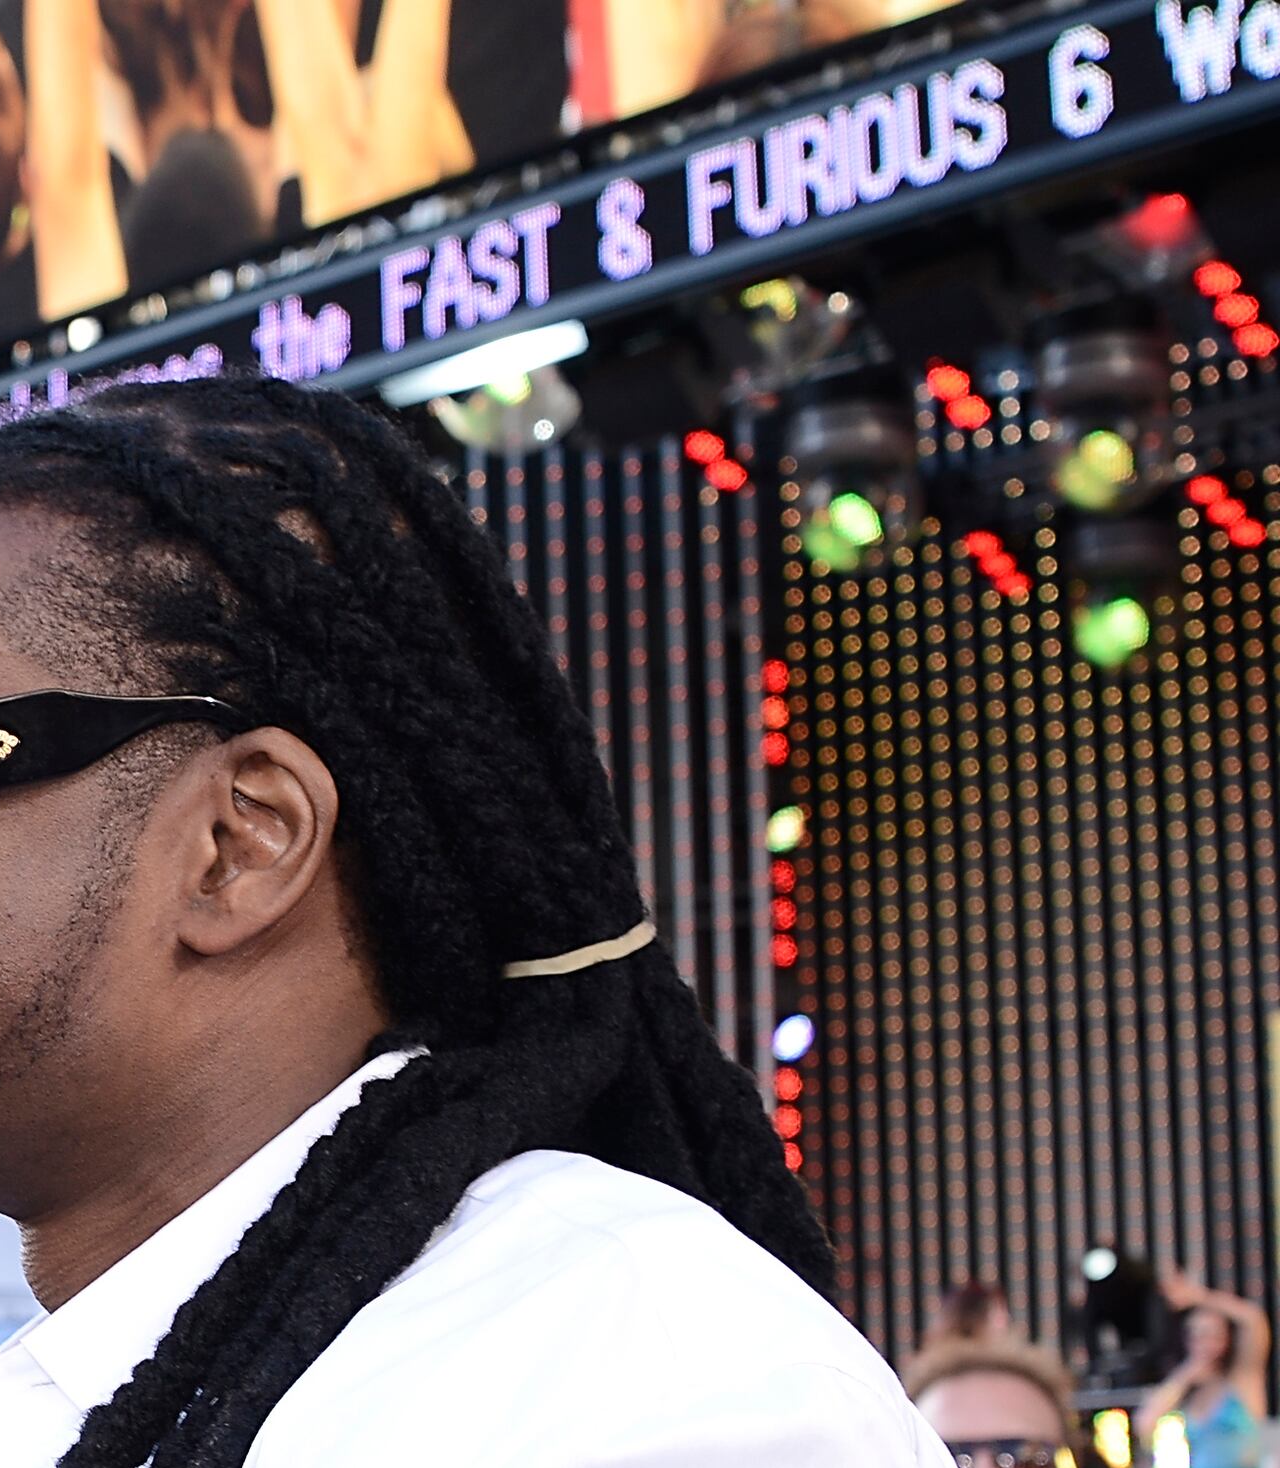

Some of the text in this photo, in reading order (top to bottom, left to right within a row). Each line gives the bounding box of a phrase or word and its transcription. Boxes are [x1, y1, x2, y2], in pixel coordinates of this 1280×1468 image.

[252, 294, 351, 383] the
[380, 202, 560, 352] FAST
[597, 177, 652, 281] &
[686, 58, 1007, 256] FURIOUS
[1048, 23, 1114, 139] 6
